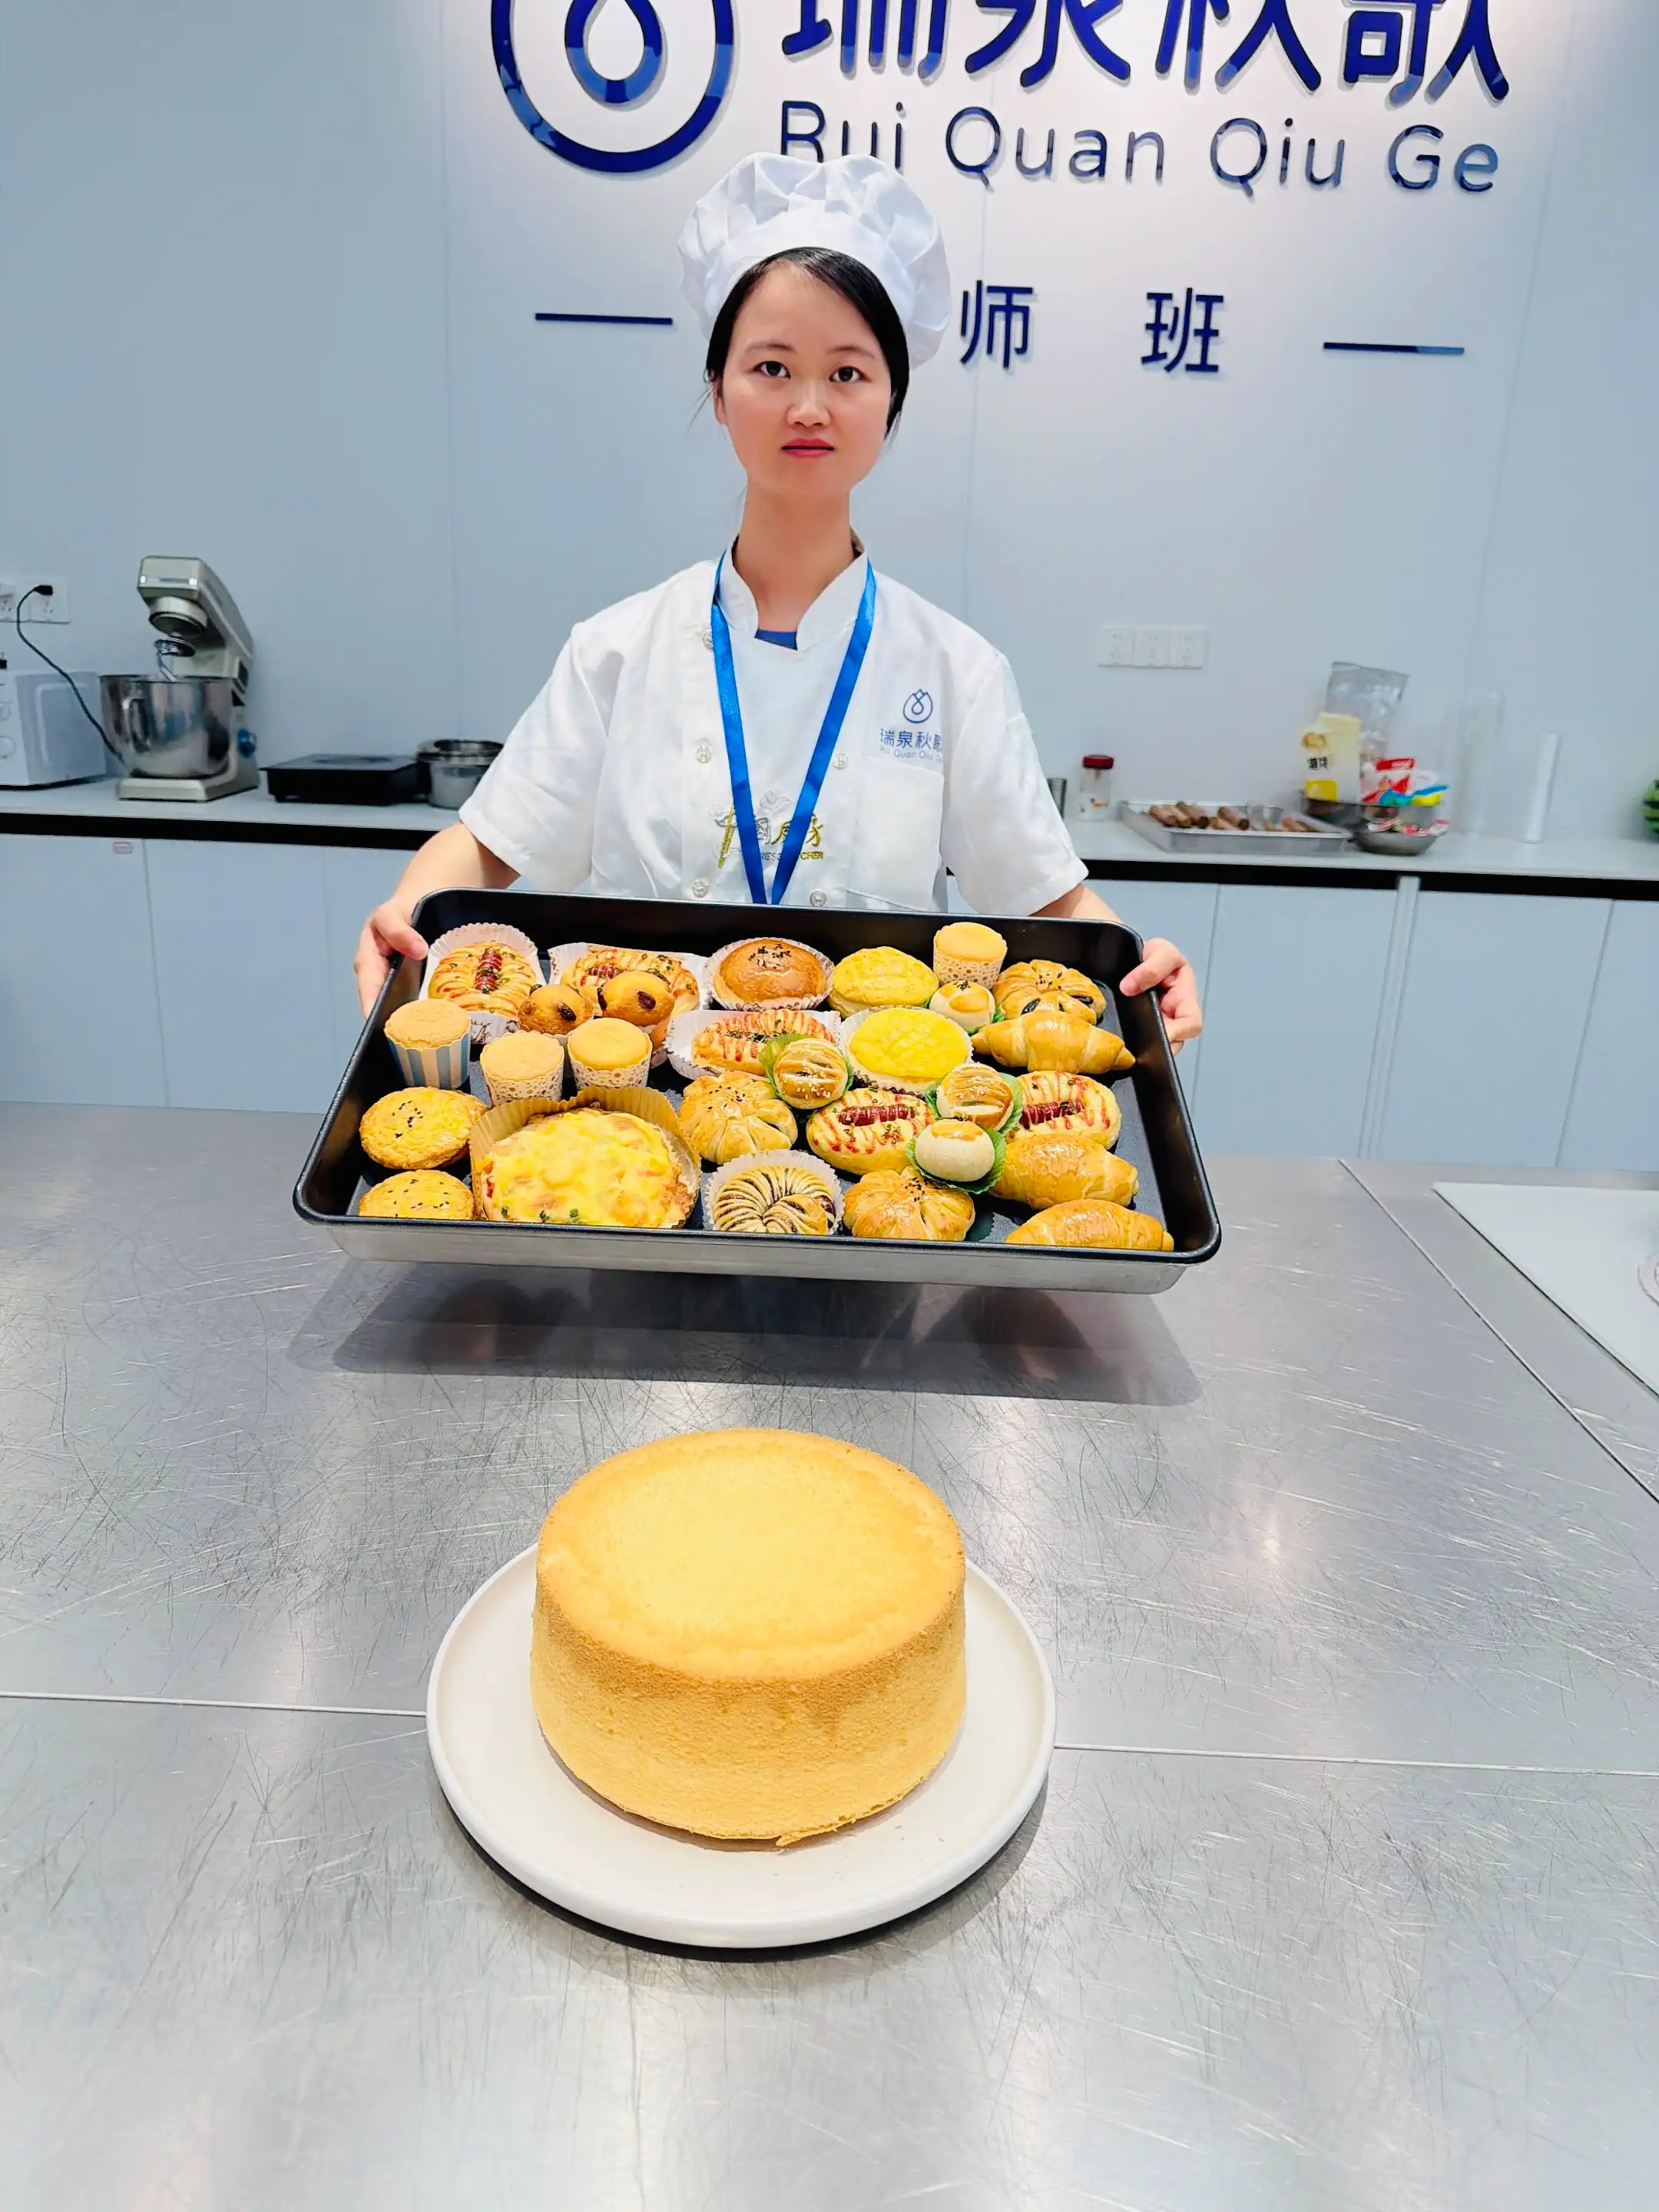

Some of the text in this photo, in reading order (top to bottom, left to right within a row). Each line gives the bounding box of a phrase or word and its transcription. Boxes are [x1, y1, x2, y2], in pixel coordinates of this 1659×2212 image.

[781, 101, 1498, 197] Rui Quan Qiu Ge
[893, 749, 916, 759] Quan
